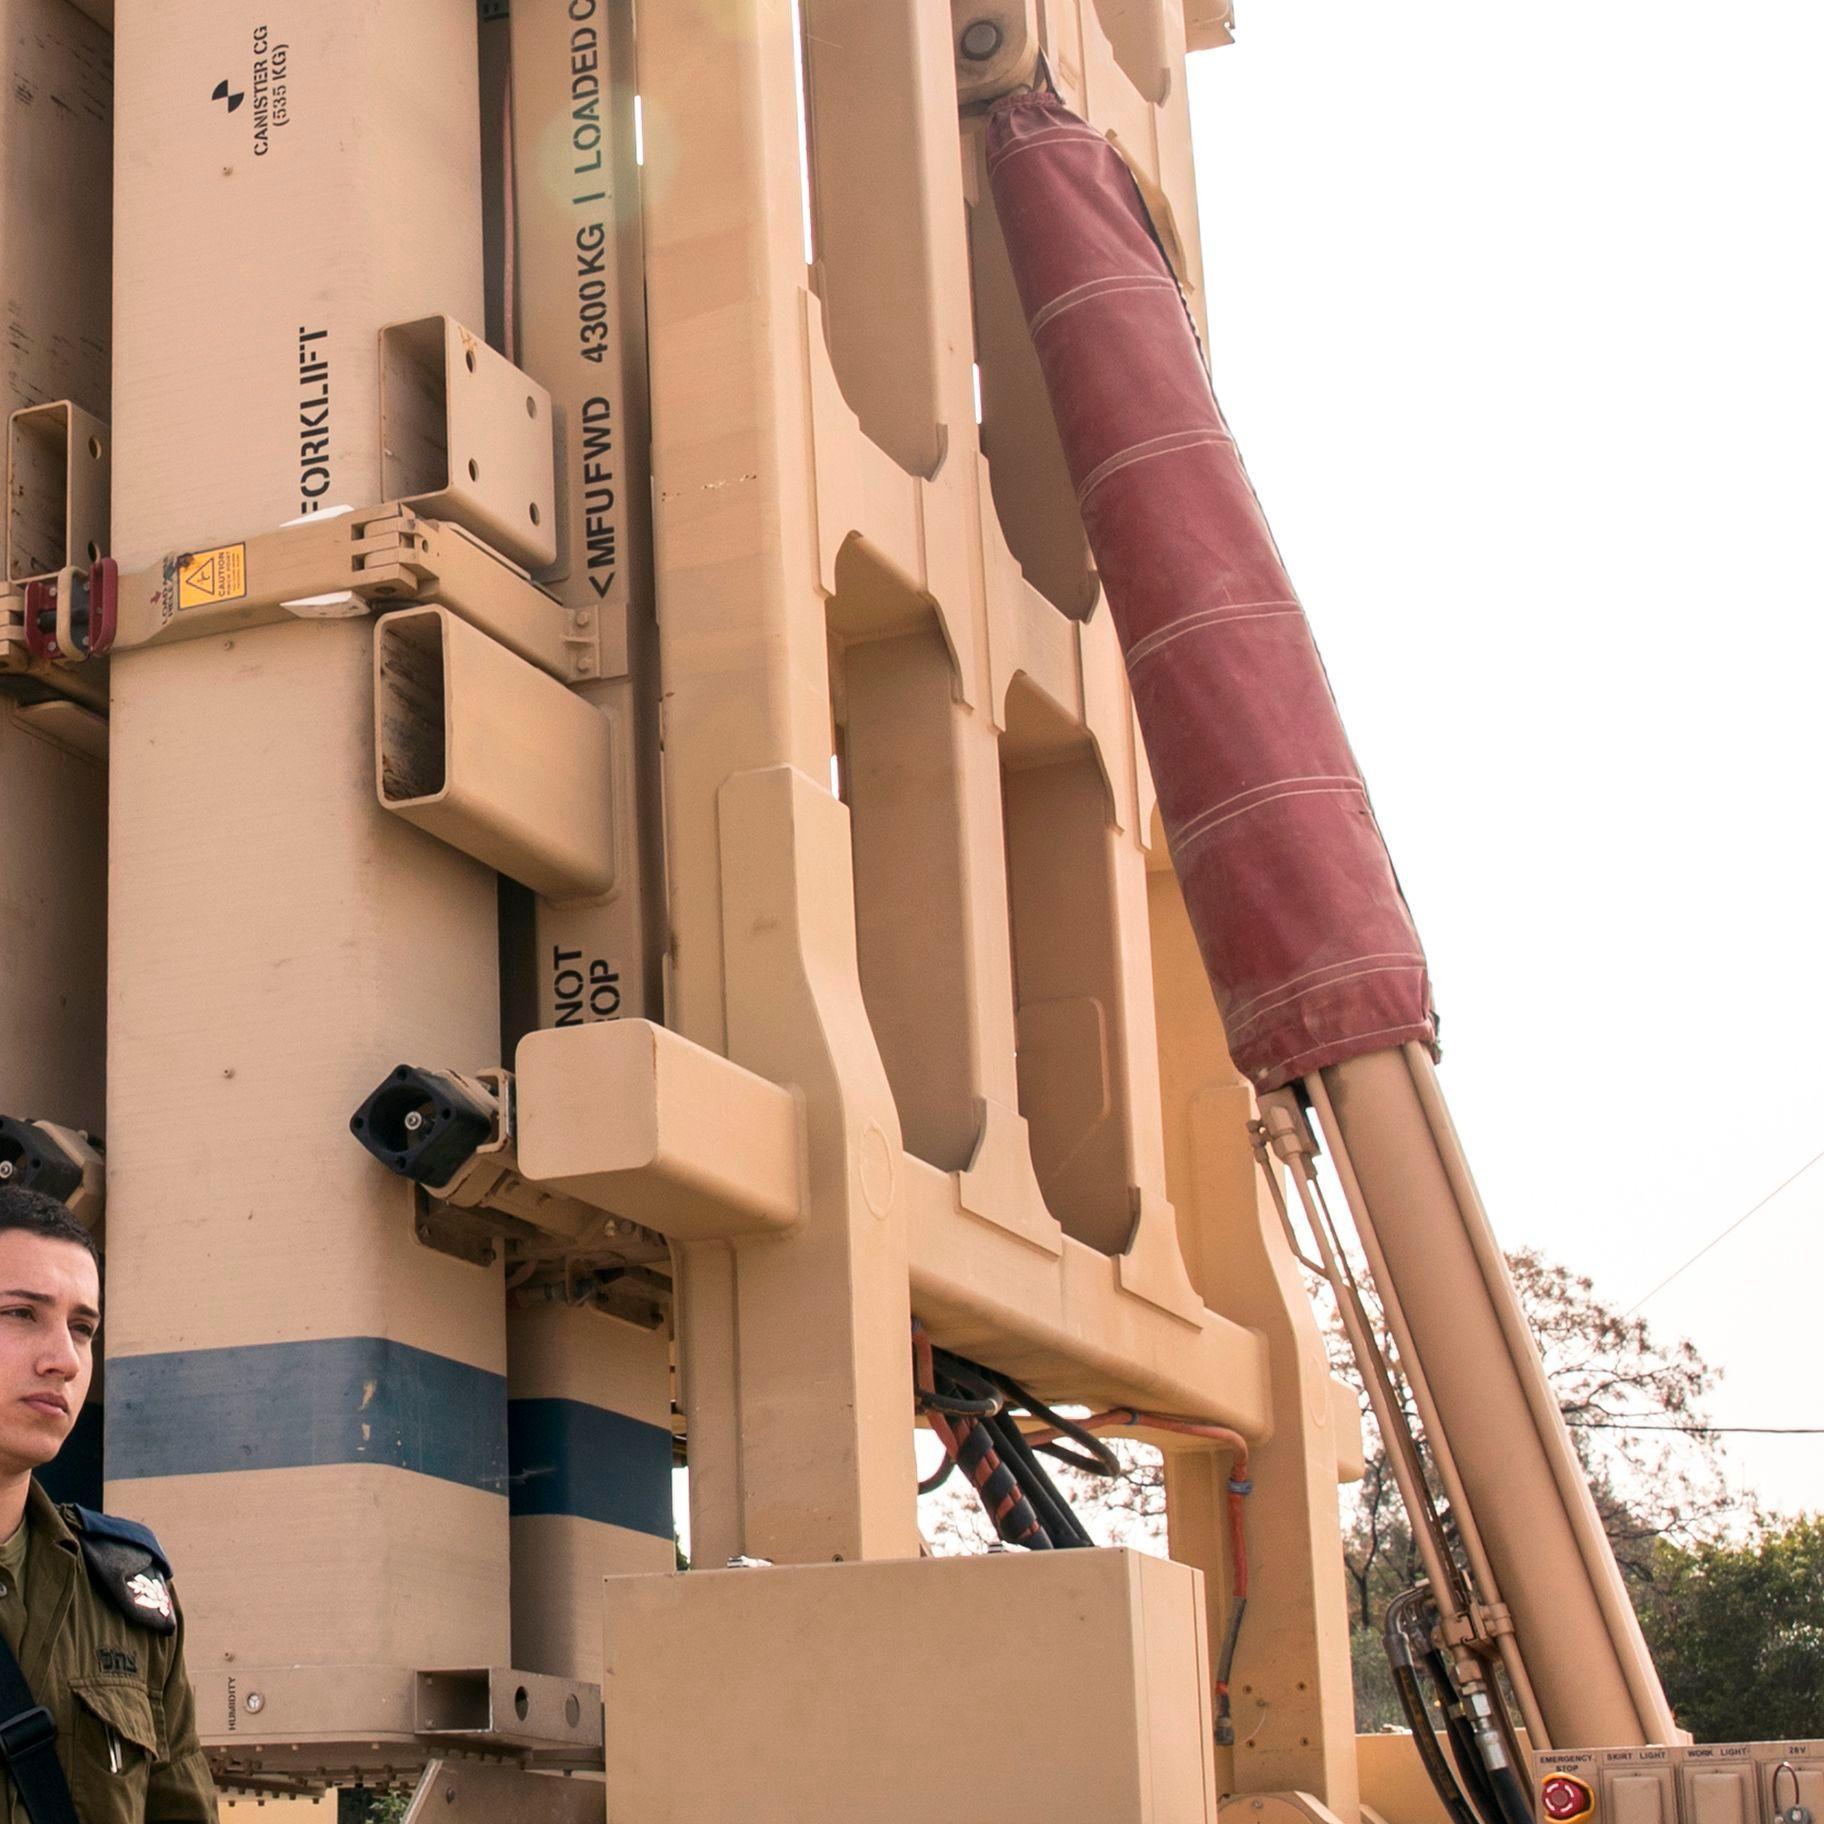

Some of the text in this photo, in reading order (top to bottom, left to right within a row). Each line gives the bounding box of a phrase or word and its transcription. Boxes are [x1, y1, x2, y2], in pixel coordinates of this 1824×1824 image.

[253, 24, 269, 156] CANISTER CG
[272, 43, 289, 127] (535 KG)
[571, 27, 601, 174] LOADED
[576, 222, 605, 276] KG
[579, 279, 608, 363] 4300
[228, 1677, 236, 1731] HUMIDITY
[1540, 1754, 1592, 1764] EMERGENCY
[1555, 1765, 1579, 1773] STOP
[1607, 1751, 1666, 1761] SKIRT LIGHT
[1687, 1747, 1746, 1758] WORK LIGHT
[1788, 1746, 1806, 1755] 28V
